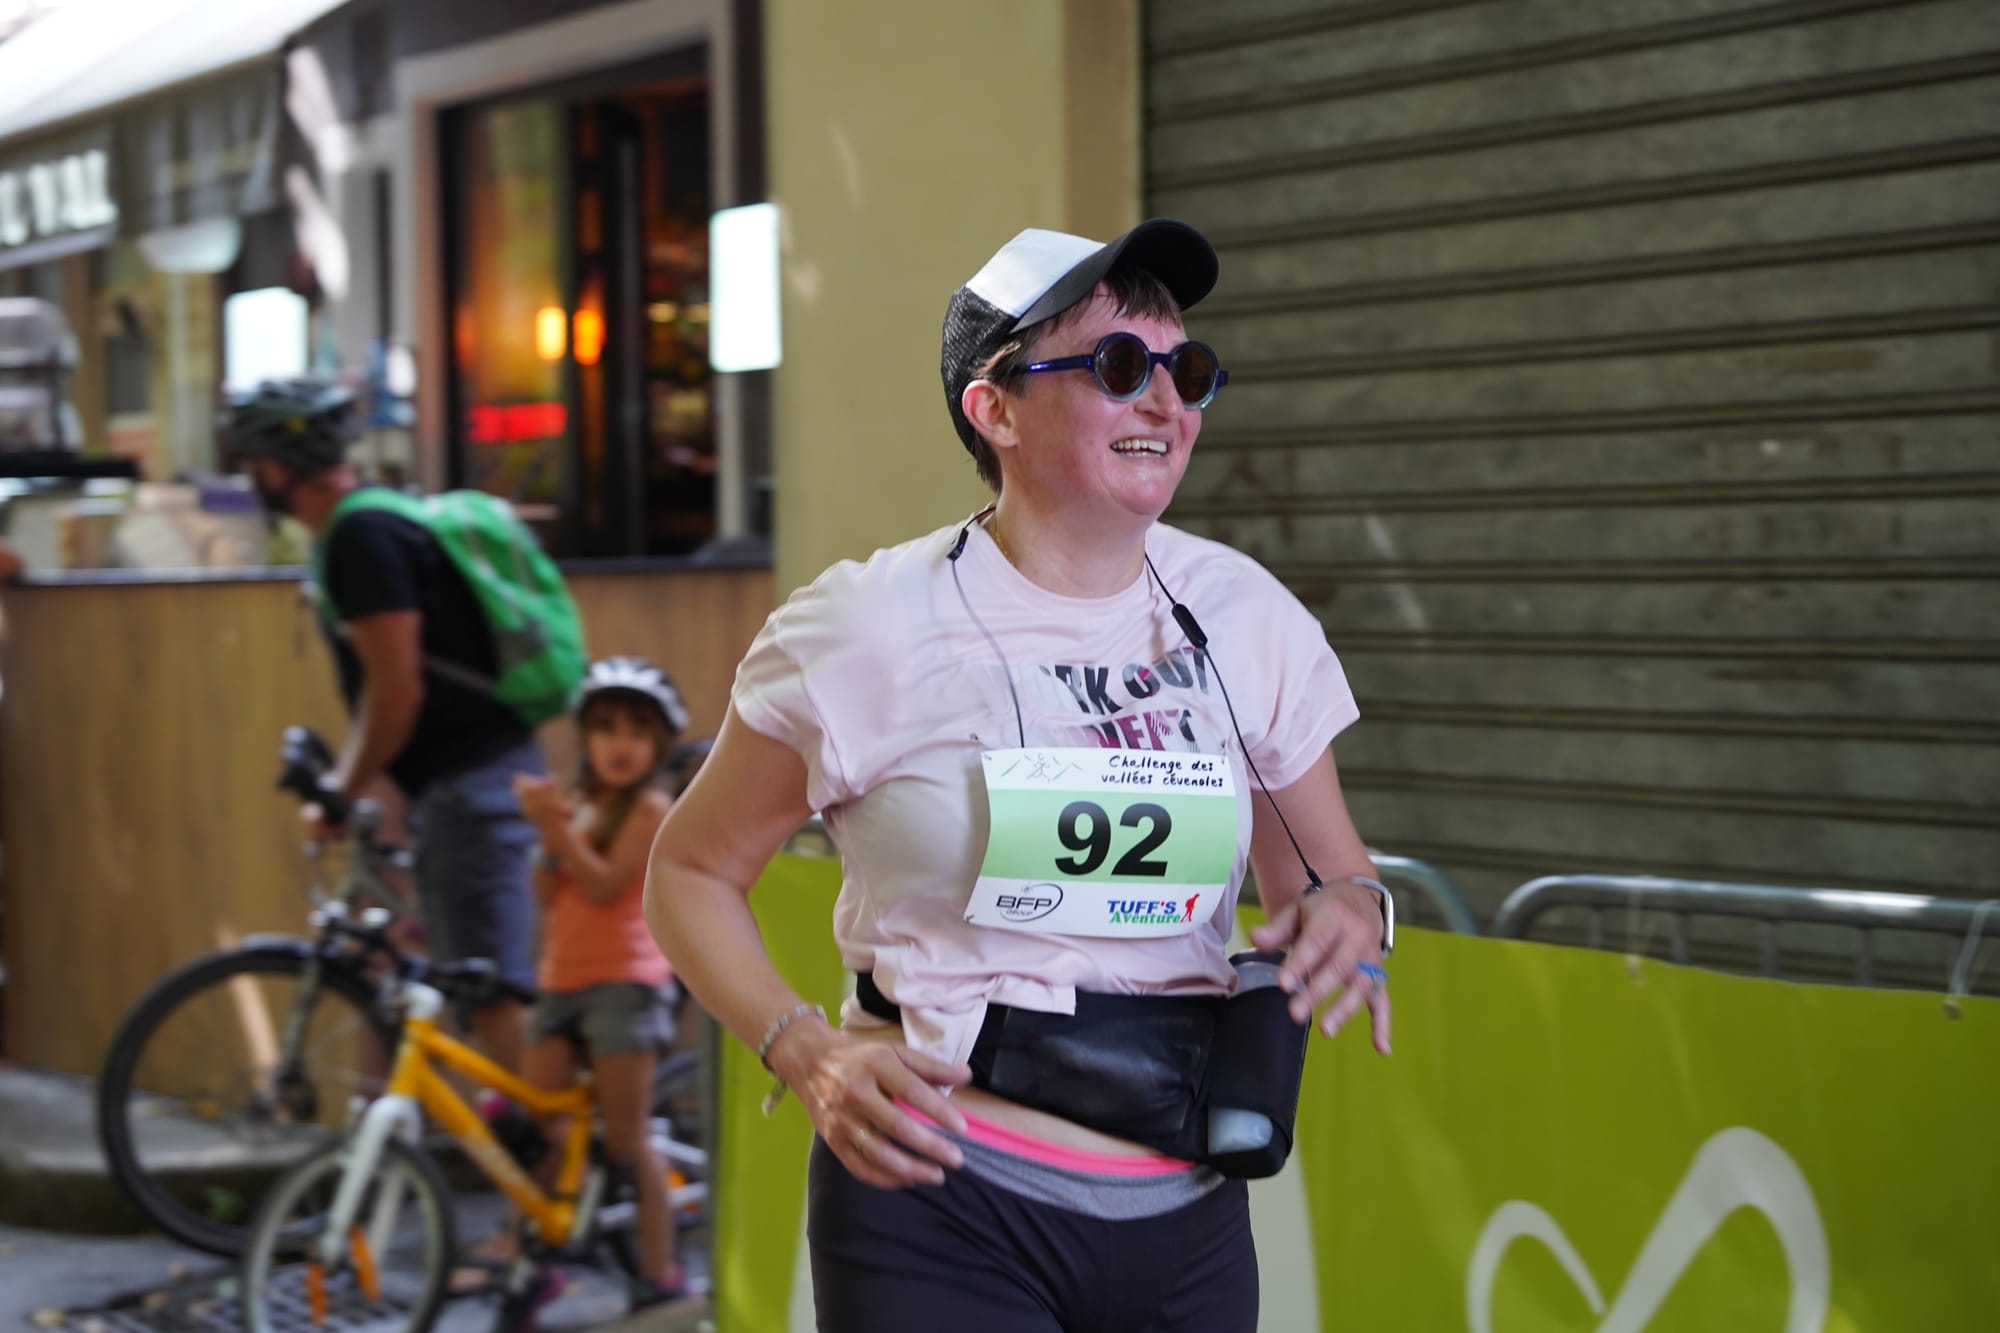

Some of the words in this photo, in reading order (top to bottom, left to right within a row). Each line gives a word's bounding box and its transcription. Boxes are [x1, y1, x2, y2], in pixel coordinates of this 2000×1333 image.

[1122, 646, 1209, 699] OUT
[1109, 755, 1182, 774] Challenge
[1191, 760, 1213, 772] des
[1101, 771, 1153, 785] vallées
[1162, 773, 1223, 788] cévenoles
[1054, 801, 1172, 878] 92
[996, 895, 1052, 911] BFP
[1107, 900, 1177, 914] TUFF'S
[1110, 911, 1181, 924] Aventure
